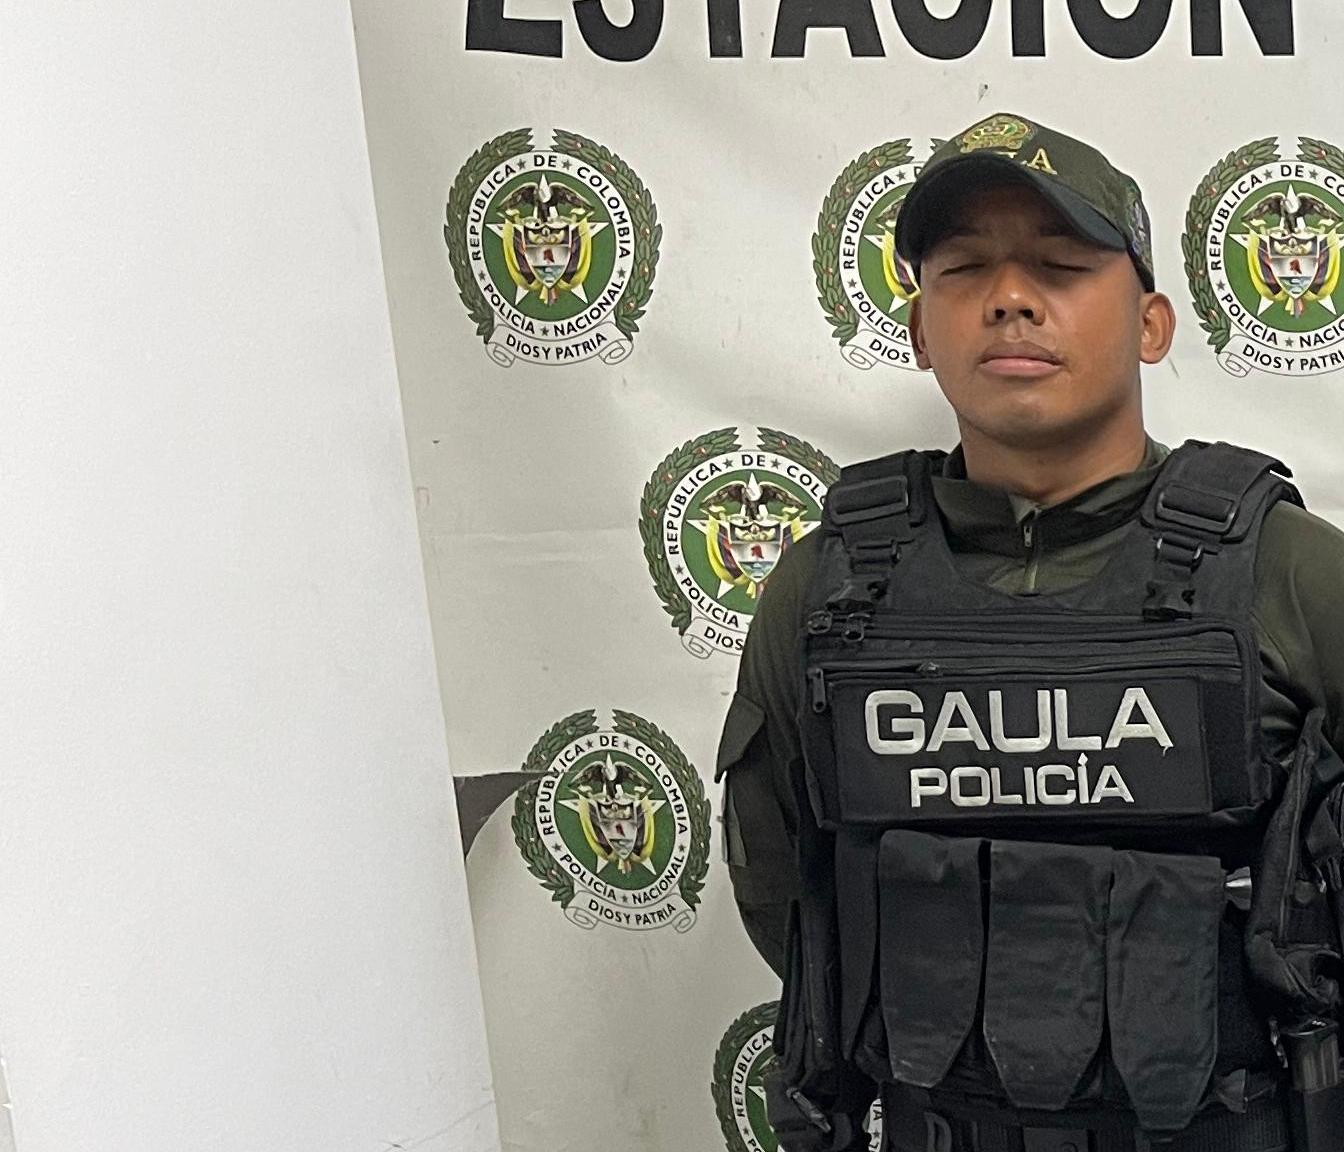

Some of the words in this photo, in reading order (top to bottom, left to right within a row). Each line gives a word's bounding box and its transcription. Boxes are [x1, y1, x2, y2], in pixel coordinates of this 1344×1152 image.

[1280, 164, 1304, 178] DE
[533, 154, 558, 168] DE
[577, 166, 631, 258] COLOMBIA
[554, 280, 624, 337] NACIONAL
[556, 332, 607, 360] PATRIA
[740, 453, 765, 467] DE
[865, 687, 1174, 755] GAULA
[599, 736, 619, 747] DE
[635, 746, 688, 834] COLOMBIA
[910, 752, 1135, 808] POLICÍA
[632, 855, 685, 904] NACIONAL
[635, 903, 676, 925] PATRIA
